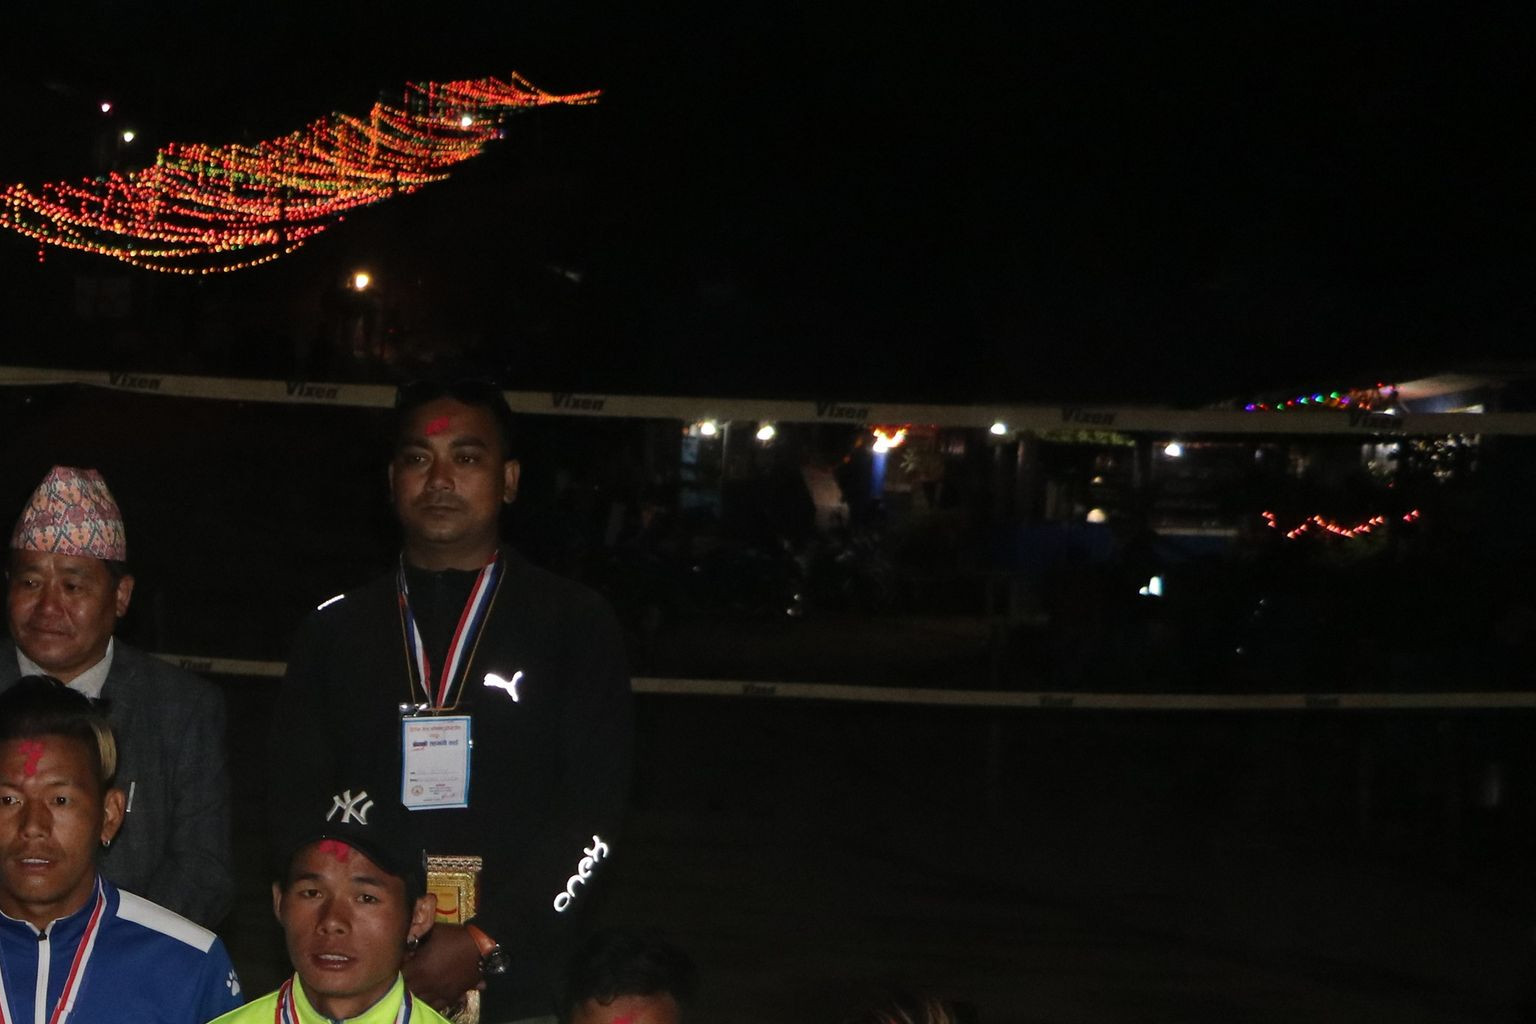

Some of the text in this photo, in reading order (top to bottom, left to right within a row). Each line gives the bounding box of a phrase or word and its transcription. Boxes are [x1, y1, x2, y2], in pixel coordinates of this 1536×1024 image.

[110, 370, 161, 389] Vixen
[287, 380, 337, 399] Vixen
[552, 392, 605, 411] Vixen
[816, 402, 869, 419] Vixen
